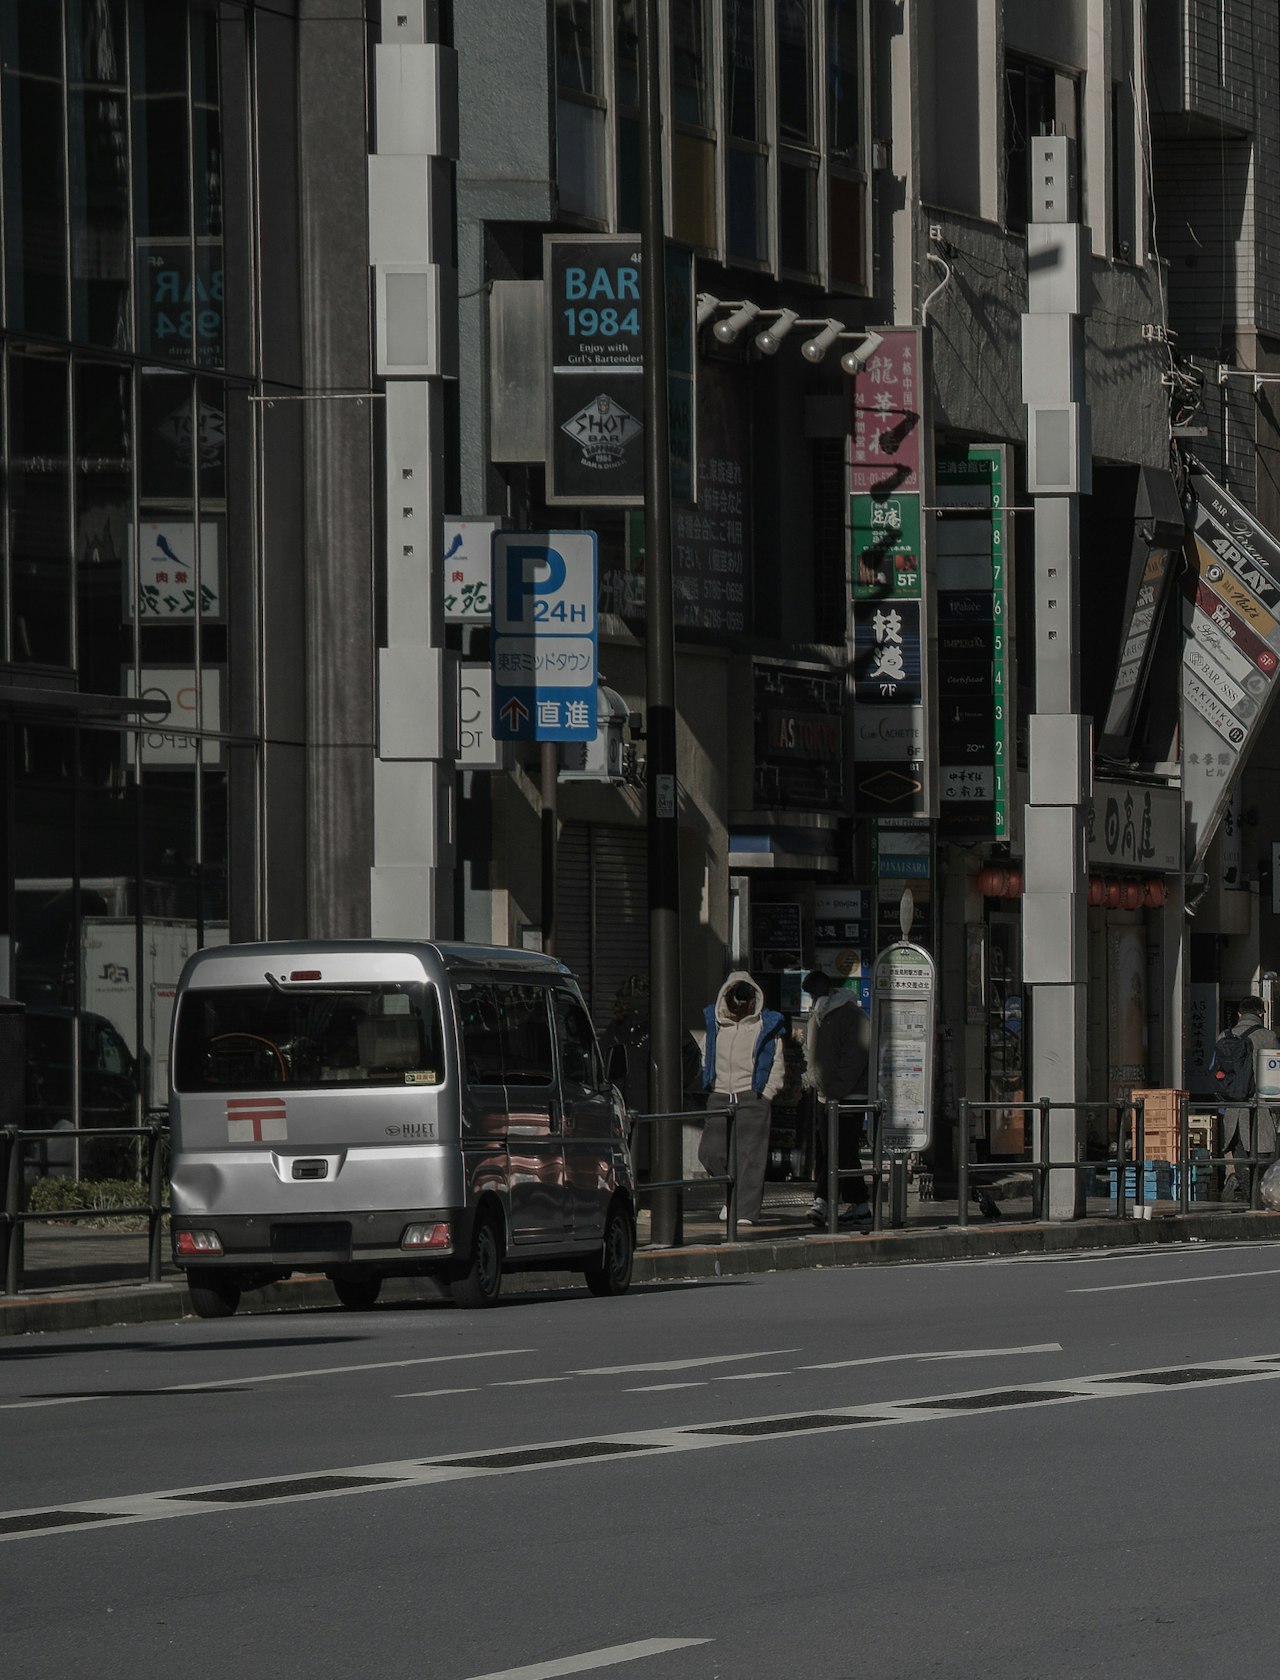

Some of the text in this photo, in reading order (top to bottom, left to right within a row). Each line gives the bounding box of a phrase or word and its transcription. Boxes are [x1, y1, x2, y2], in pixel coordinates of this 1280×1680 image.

[565, 267, 640, 300] BAR
[564, 307, 640, 336] 1984
[579, 343, 628, 353] Enjoy with
[568, 354, 592, 364] Girl's
[575, 413, 630, 435] SHOT
[993, 495, 999, 508] 9
[1211, 499, 1228, 517] BAR
[993, 530, 1000, 545] 8
[994, 566, 1000, 580] 7
[1212, 539, 1274, 594] 4PLAY
[452, 571, 464, 582] 肉
[507, 546, 566, 621] P
[897, 573, 917, 586] 5F
[533, 602, 586, 622] 24H
[995, 601, 1001, 616] 6
[995, 635, 1001, 650] 5
[498, 654, 590, 672] 東京ミッドタウン
[1260, 655, 1273, 667] 5F
[995, 671, 1001, 685] 4
[880, 684, 897, 696] 7F
[1188, 679, 1233, 727] YAKINIKU
[537, 701, 589, 729] 直進
[995, 706, 1001, 721] 3
[907, 745, 920, 757] 6F
[996, 741, 1002, 757] 2
[1206, 769, 1225, 777] ビル
[862, 988, 870, 998] 5
[403, 1124, 434, 1134] HIJET
